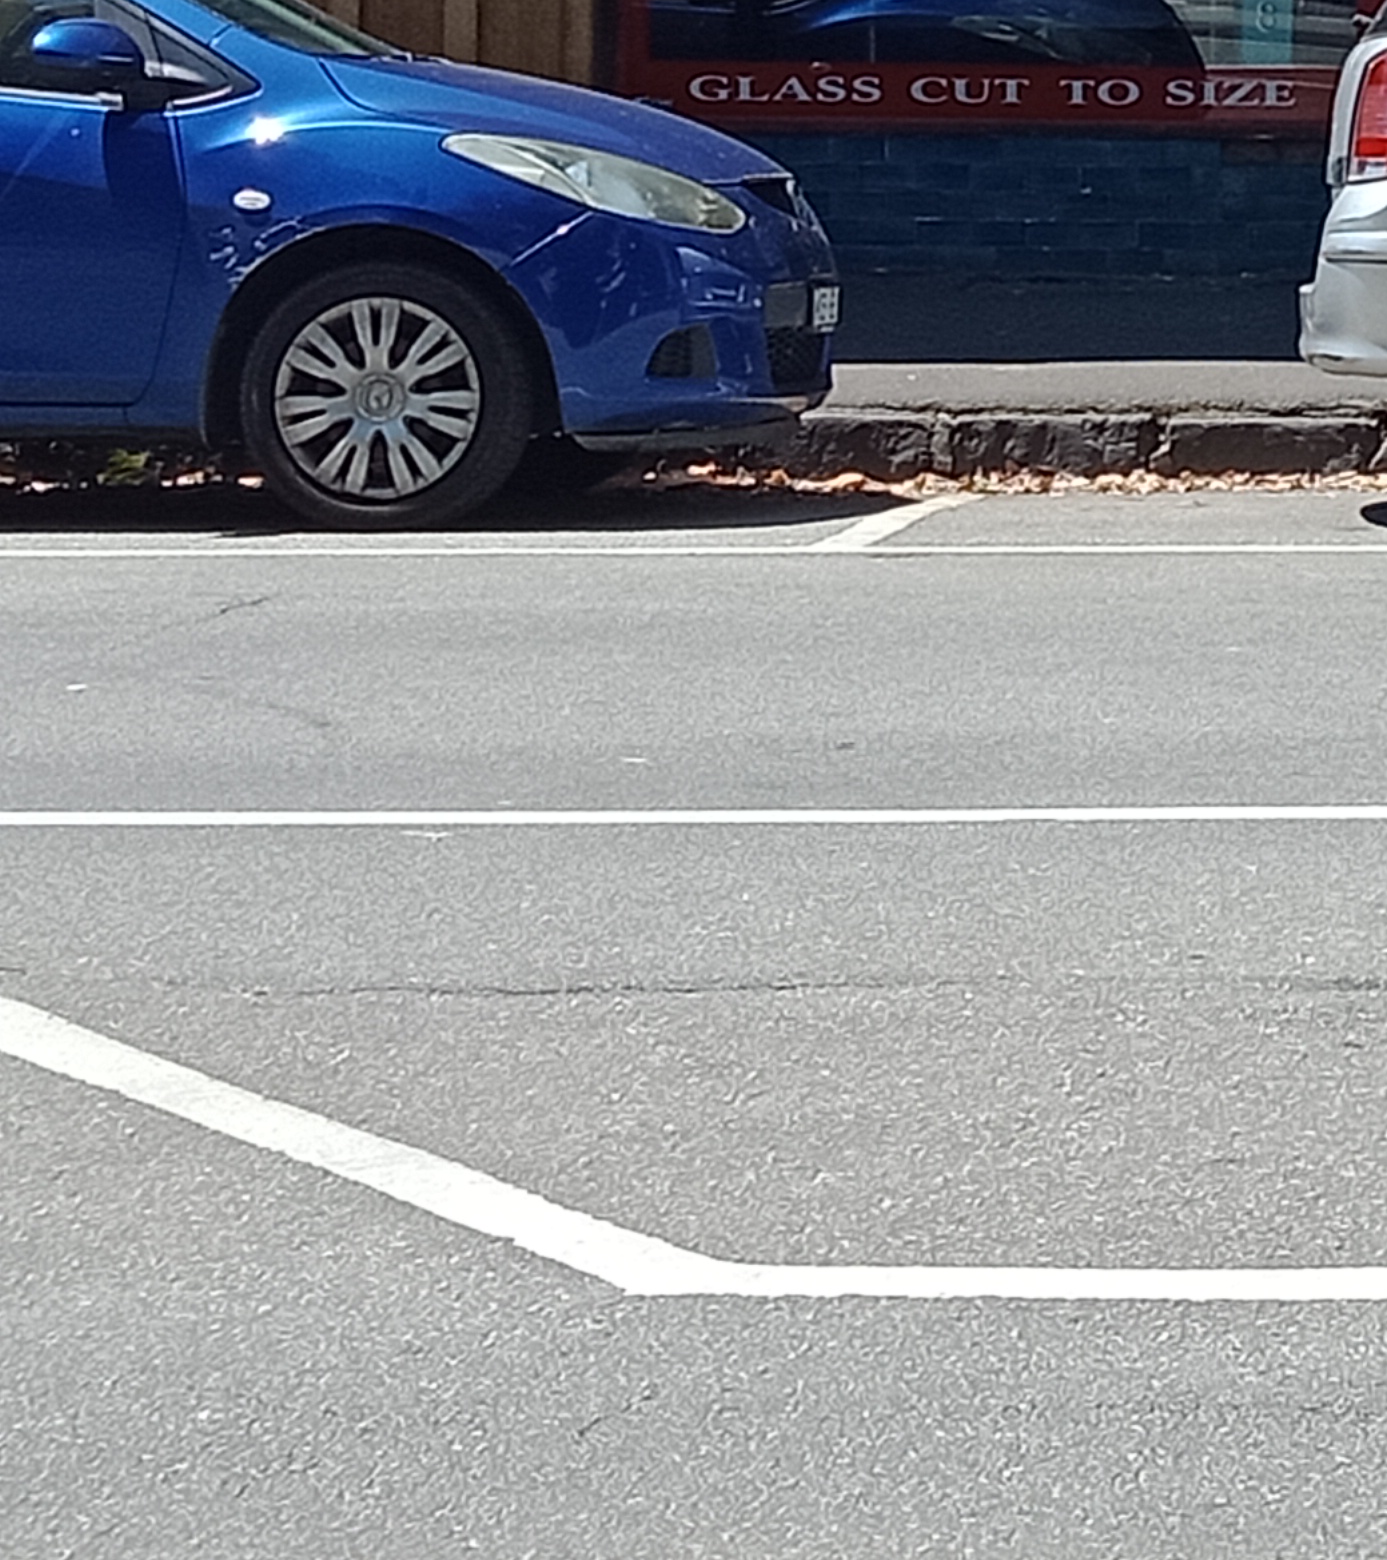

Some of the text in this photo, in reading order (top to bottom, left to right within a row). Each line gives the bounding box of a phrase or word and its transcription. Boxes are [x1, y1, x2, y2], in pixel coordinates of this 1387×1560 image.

[687, 74, 1297, 109] GLASS CUT TO SIZE
